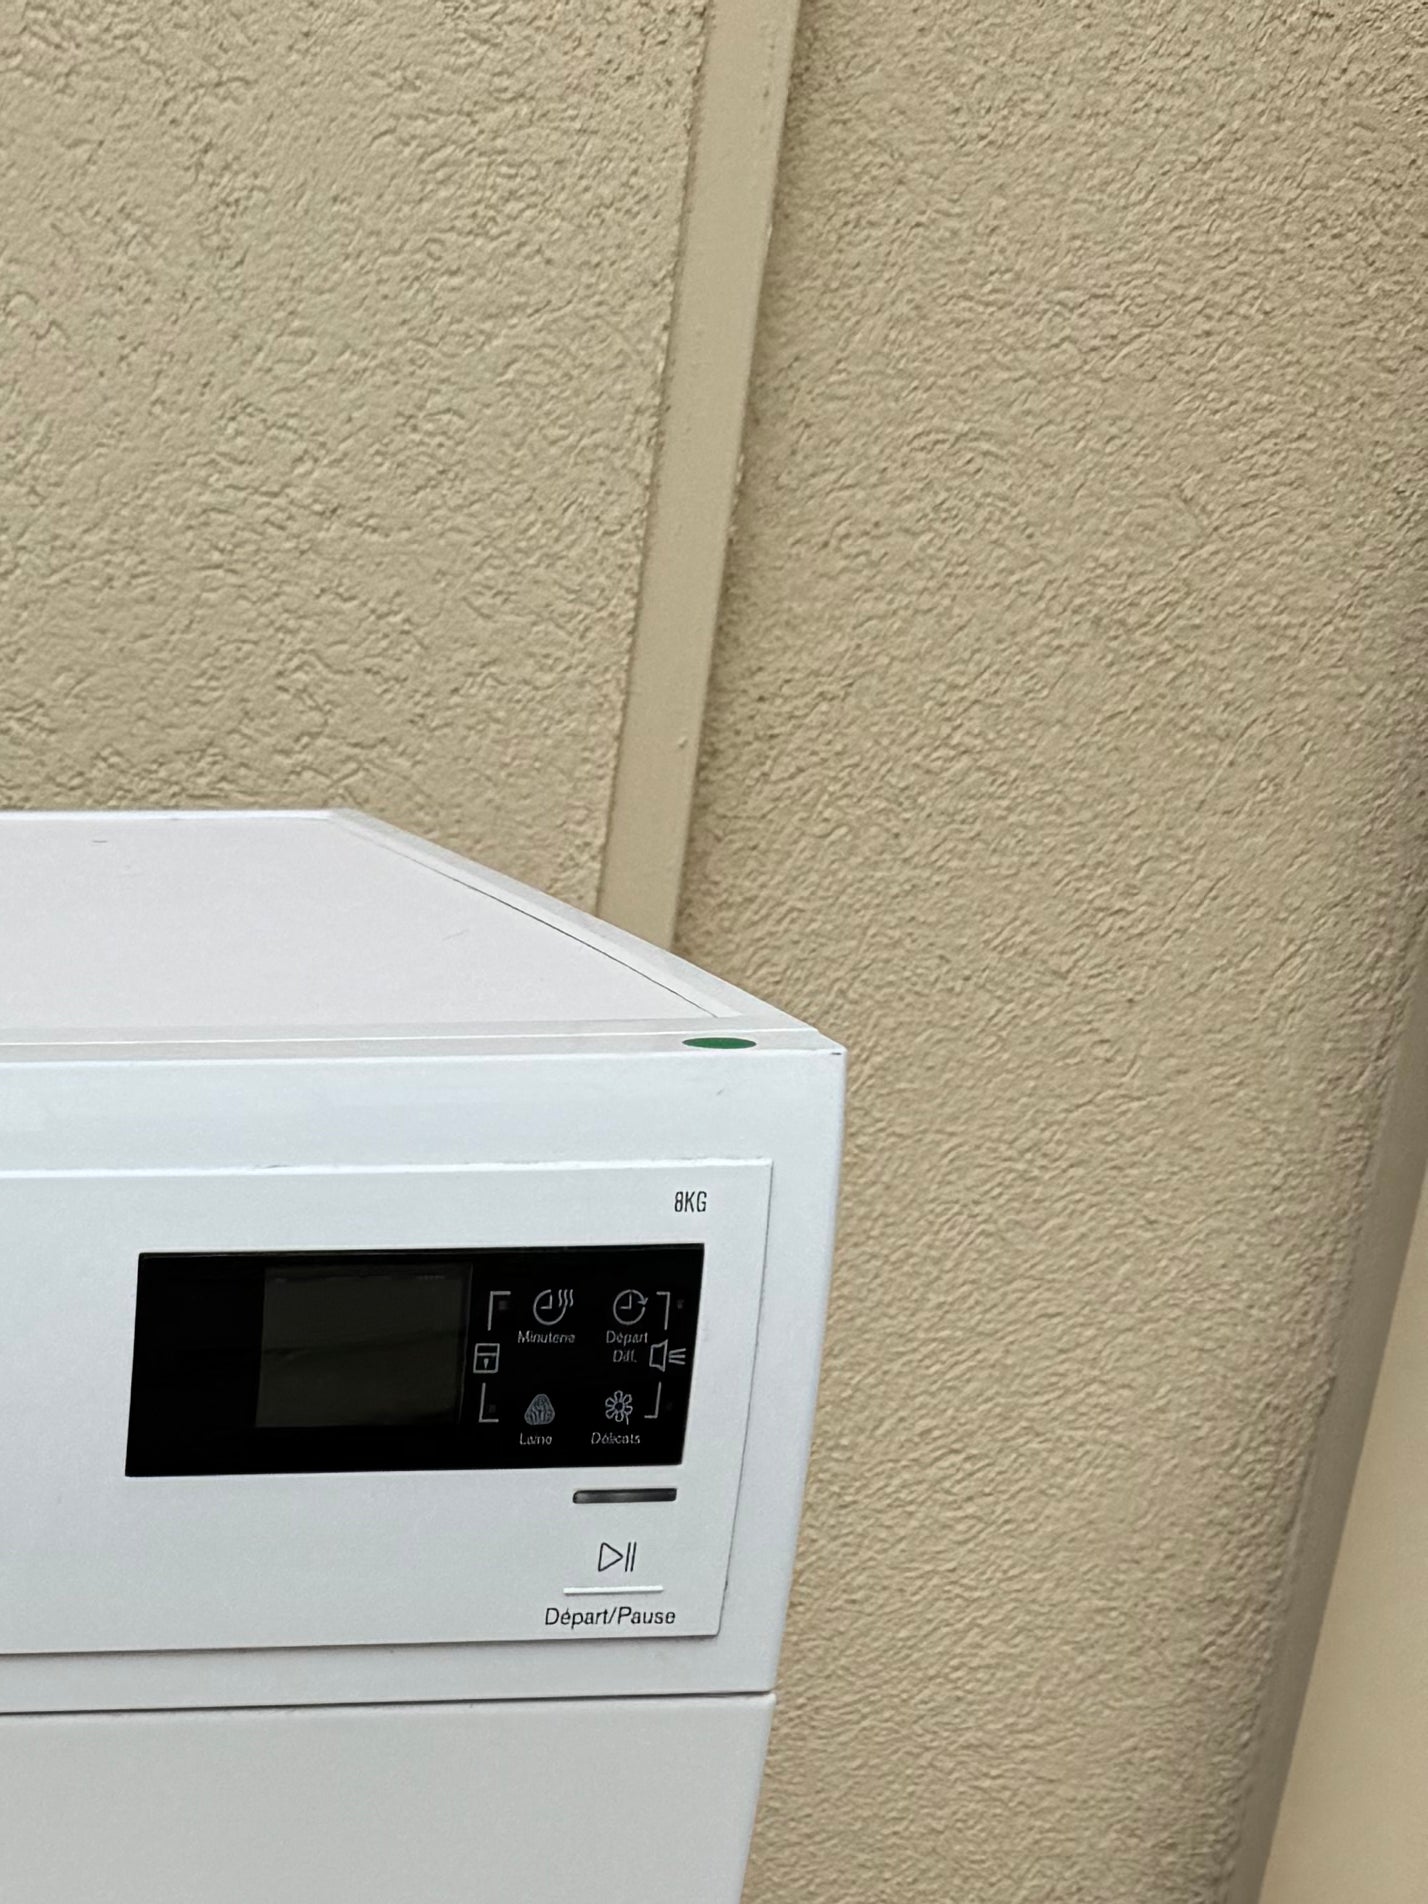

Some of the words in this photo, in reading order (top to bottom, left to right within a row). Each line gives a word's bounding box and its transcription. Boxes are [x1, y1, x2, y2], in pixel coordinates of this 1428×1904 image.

[674, 1191, 707, 1213] 8KG
[606, 1330, 648, 1347] Départ
[545, 1606, 676, 1628] Départ/Pause
